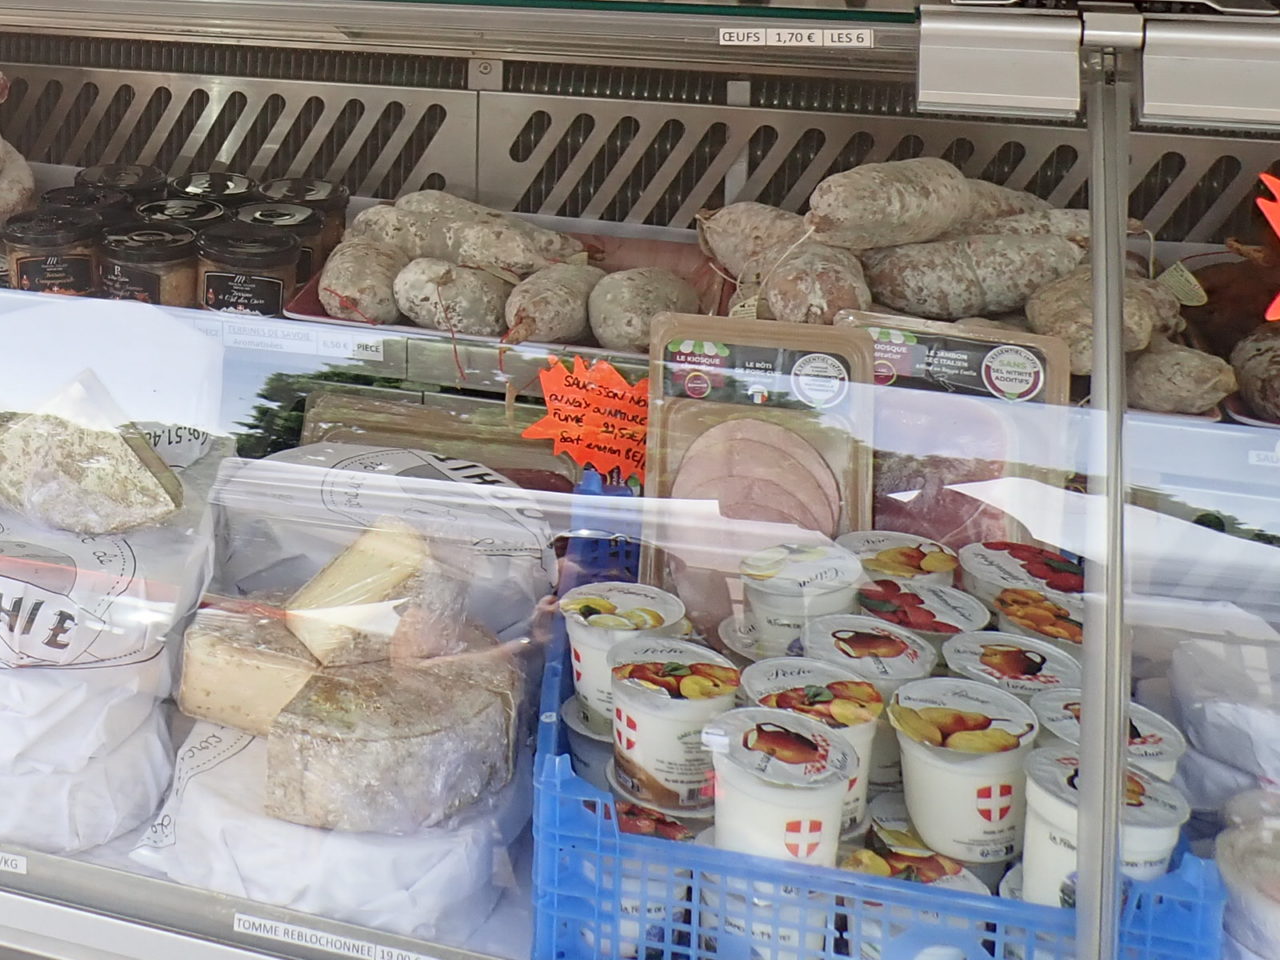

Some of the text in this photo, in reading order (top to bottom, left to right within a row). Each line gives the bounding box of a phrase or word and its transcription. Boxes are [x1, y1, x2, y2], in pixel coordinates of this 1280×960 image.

[722, 31, 864, 44] ŒUFS 1,70 € LES 6
[228, 325, 311, 341] TERRINES DE SAVOIE
[687, 356, 721, 365] KIOSQUE
[998, 359, 1028, 369] SANS
[991, 367, 1005, 375] SEL
[564, 375, 627, 401] SAUCSSON
[237, 917, 280, 937] TOMME
[282, 926, 373, 958] REBLOCHONNEE
